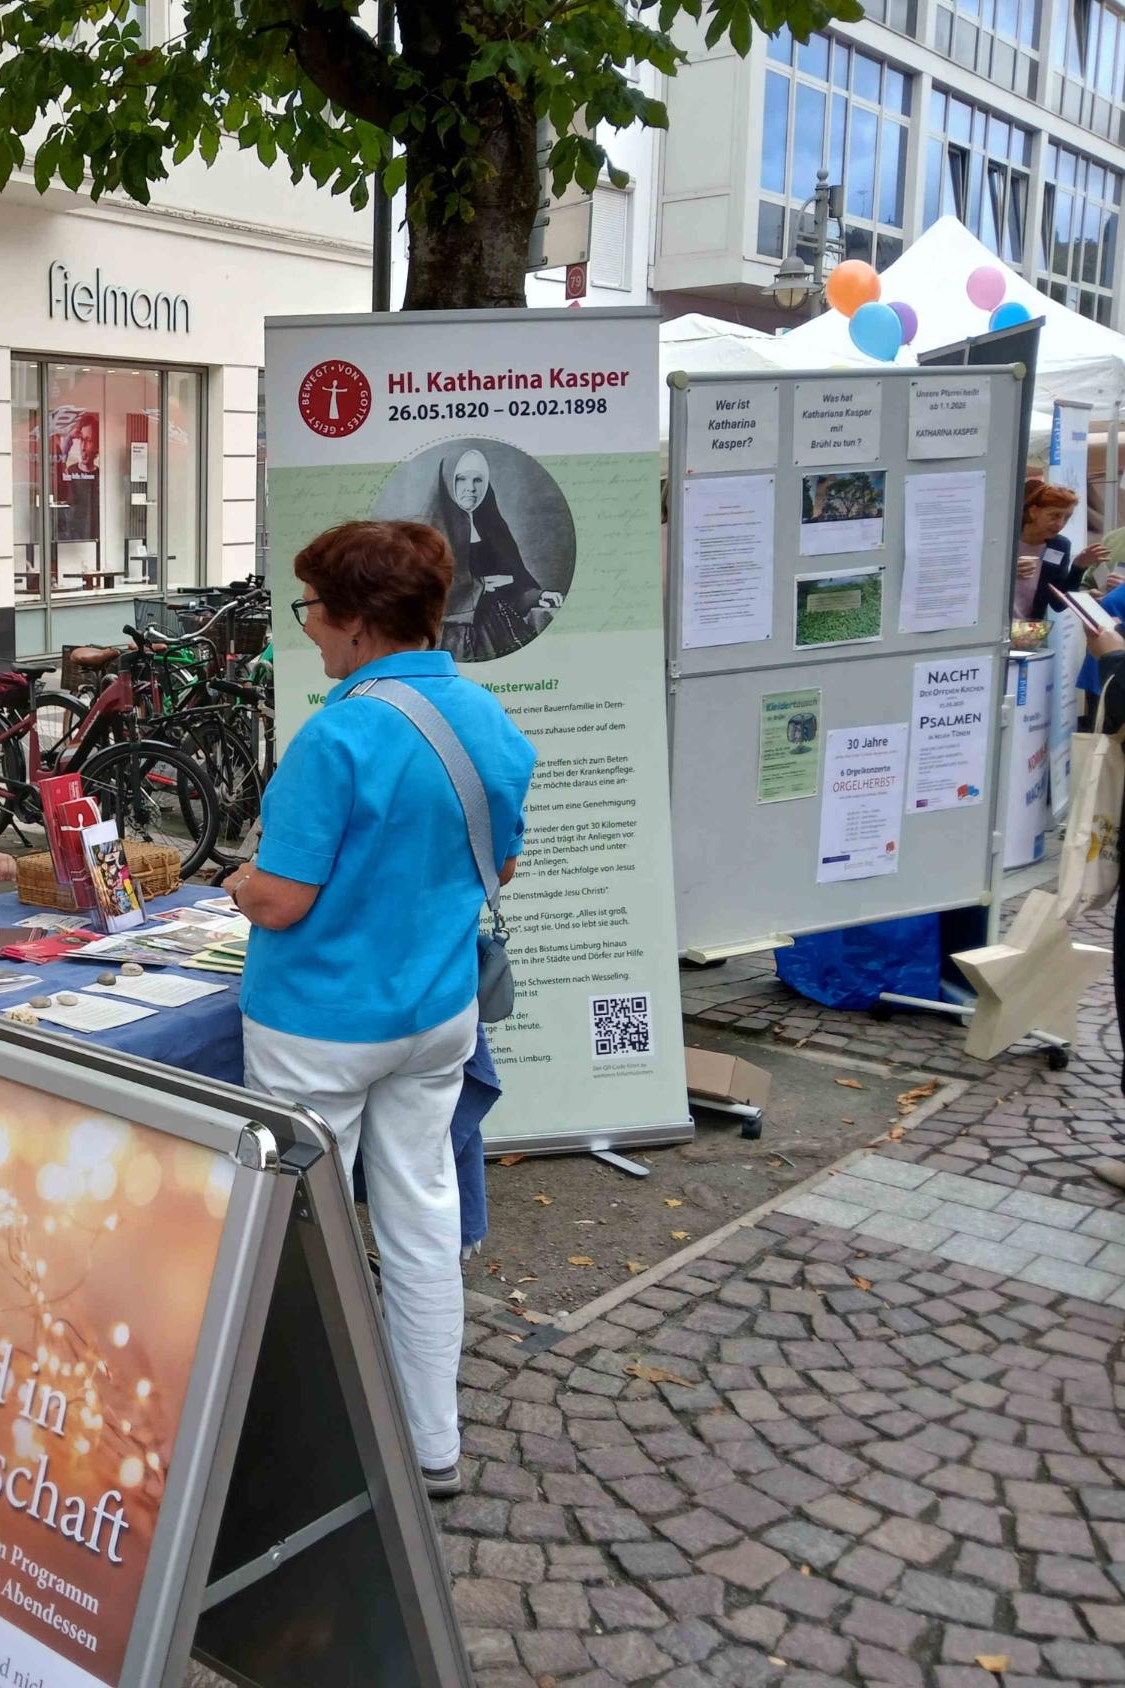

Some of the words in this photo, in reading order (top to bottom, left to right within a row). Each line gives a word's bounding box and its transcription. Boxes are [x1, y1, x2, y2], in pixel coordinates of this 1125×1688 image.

[570, 275, 582, 288] 79
[338, 363, 360, 380] VON
[301, 365, 328, 406] BEWEGT
[388, 372, 421, 394] Hl.
[427, 369, 541, 393] Katharina
[549, 367, 630, 390] Kasper
[823, 394, 839, 403] Was
[840, 393, 853, 402] hat
[347, 390, 369, 430] GOTTES
[388, 402, 489, 422] 26.05.1820
[509, 398, 608, 417] 02.02.1898
[716, 400, 736, 411] Wer
[737, 399, 750, 409] ist
[845, 408, 872, 418] Kasper
[308, 416, 337, 434] GEIST
[708, 418, 756, 430] Katharina
[830, 424, 843, 432] mit
[916, 428, 952, 438] KATHARINA
[953, 427, 978, 436] KASPER
[712, 437, 753, 450] Kasper?
[811, 440, 832, 449] Brühl
[843, 439, 855, 447] tun
[928, 668, 979, 685] NACHT
[307, 693, 327, 705] We
[481, 679, 559, 694] Westerwald?
[505, 706, 521, 714] Kind
[544, 703, 594, 712] Bauernfamilie
[605, 701, 625, 709] Dern-
[920, 712, 982, 729] PSALMEN
[545, 726, 575, 734] zuhause
[577, 724, 594, 732] oder
[595, 723, 608, 731] auf
[609, 722, 626, 730] dem
[847, 738, 859, 750] 30
[862, 737, 889, 748] Jahre
[535, 760, 546, 768] Sie
[547, 758, 572, 767] treffen
[573, 757, 587, 765] sich
[537, 770, 551, 778] und
[580, 766, 635, 776] Krankenpflege.
[531, 782, 542, 790] Sie
[543, 781, 571, 789] möchte
[573, 779, 598, 787] daraus
[833, 775, 896, 793] ORGELHERBST
[530, 804, 550, 812] bittet
[583, 799, 636, 808] Genehmigung
[534, 825, 559, 833] wieder
[576, 824, 589, 832] gut
[591, 822, 600, 831] 30
[602, 821, 637, 829] Kilometer
[541, 836, 555, 844] und
[557, 835, 575, 844] trägt
[588, 832, 621, 841] Anliegen
[553, 843, 588, 854] Dernbach
[590, 843, 605, 851] und
[517, 859, 531, 867] und
[533, 858, 569, 867] Anliegen.
[561, 866, 599, 875] Nachfolge
[513, 890, 563, 900] Dienstmägde
[524, 912, 539, 921] und
[540, 912, 573, 920] Fürsorge.
[576, 909, 597, 919] „Alles
[608, 907, 627, 917] groß,
[523, 924, 539, 933] sagt
[541, 923, 553, 931] sie.
[555, 921, 570, 930] Und
[582, 920, 596, 928] lebt
[610, 917, 629, 926] auch.
[525, 946, 537, 954] des
[570, 942, 601, 953] Limburg
[546, 953, 570, 963] Städte
[572, 953, 586, 961] und
[588, 951, 611, 960] Dörfer
[626, 949, 644, 957] Hilfe
[528, 977, 571, 986] Schwestern
[573, 974, 590, 982] nach
[592, 972, 630, 981] Wesseling.
[518, 1022, 542, 1030] heute.
[20, 1362, 67, 1436] in
[10, 1544, 99, 1616] Programm
[0, 1578, 99, 1653] Abendessen
